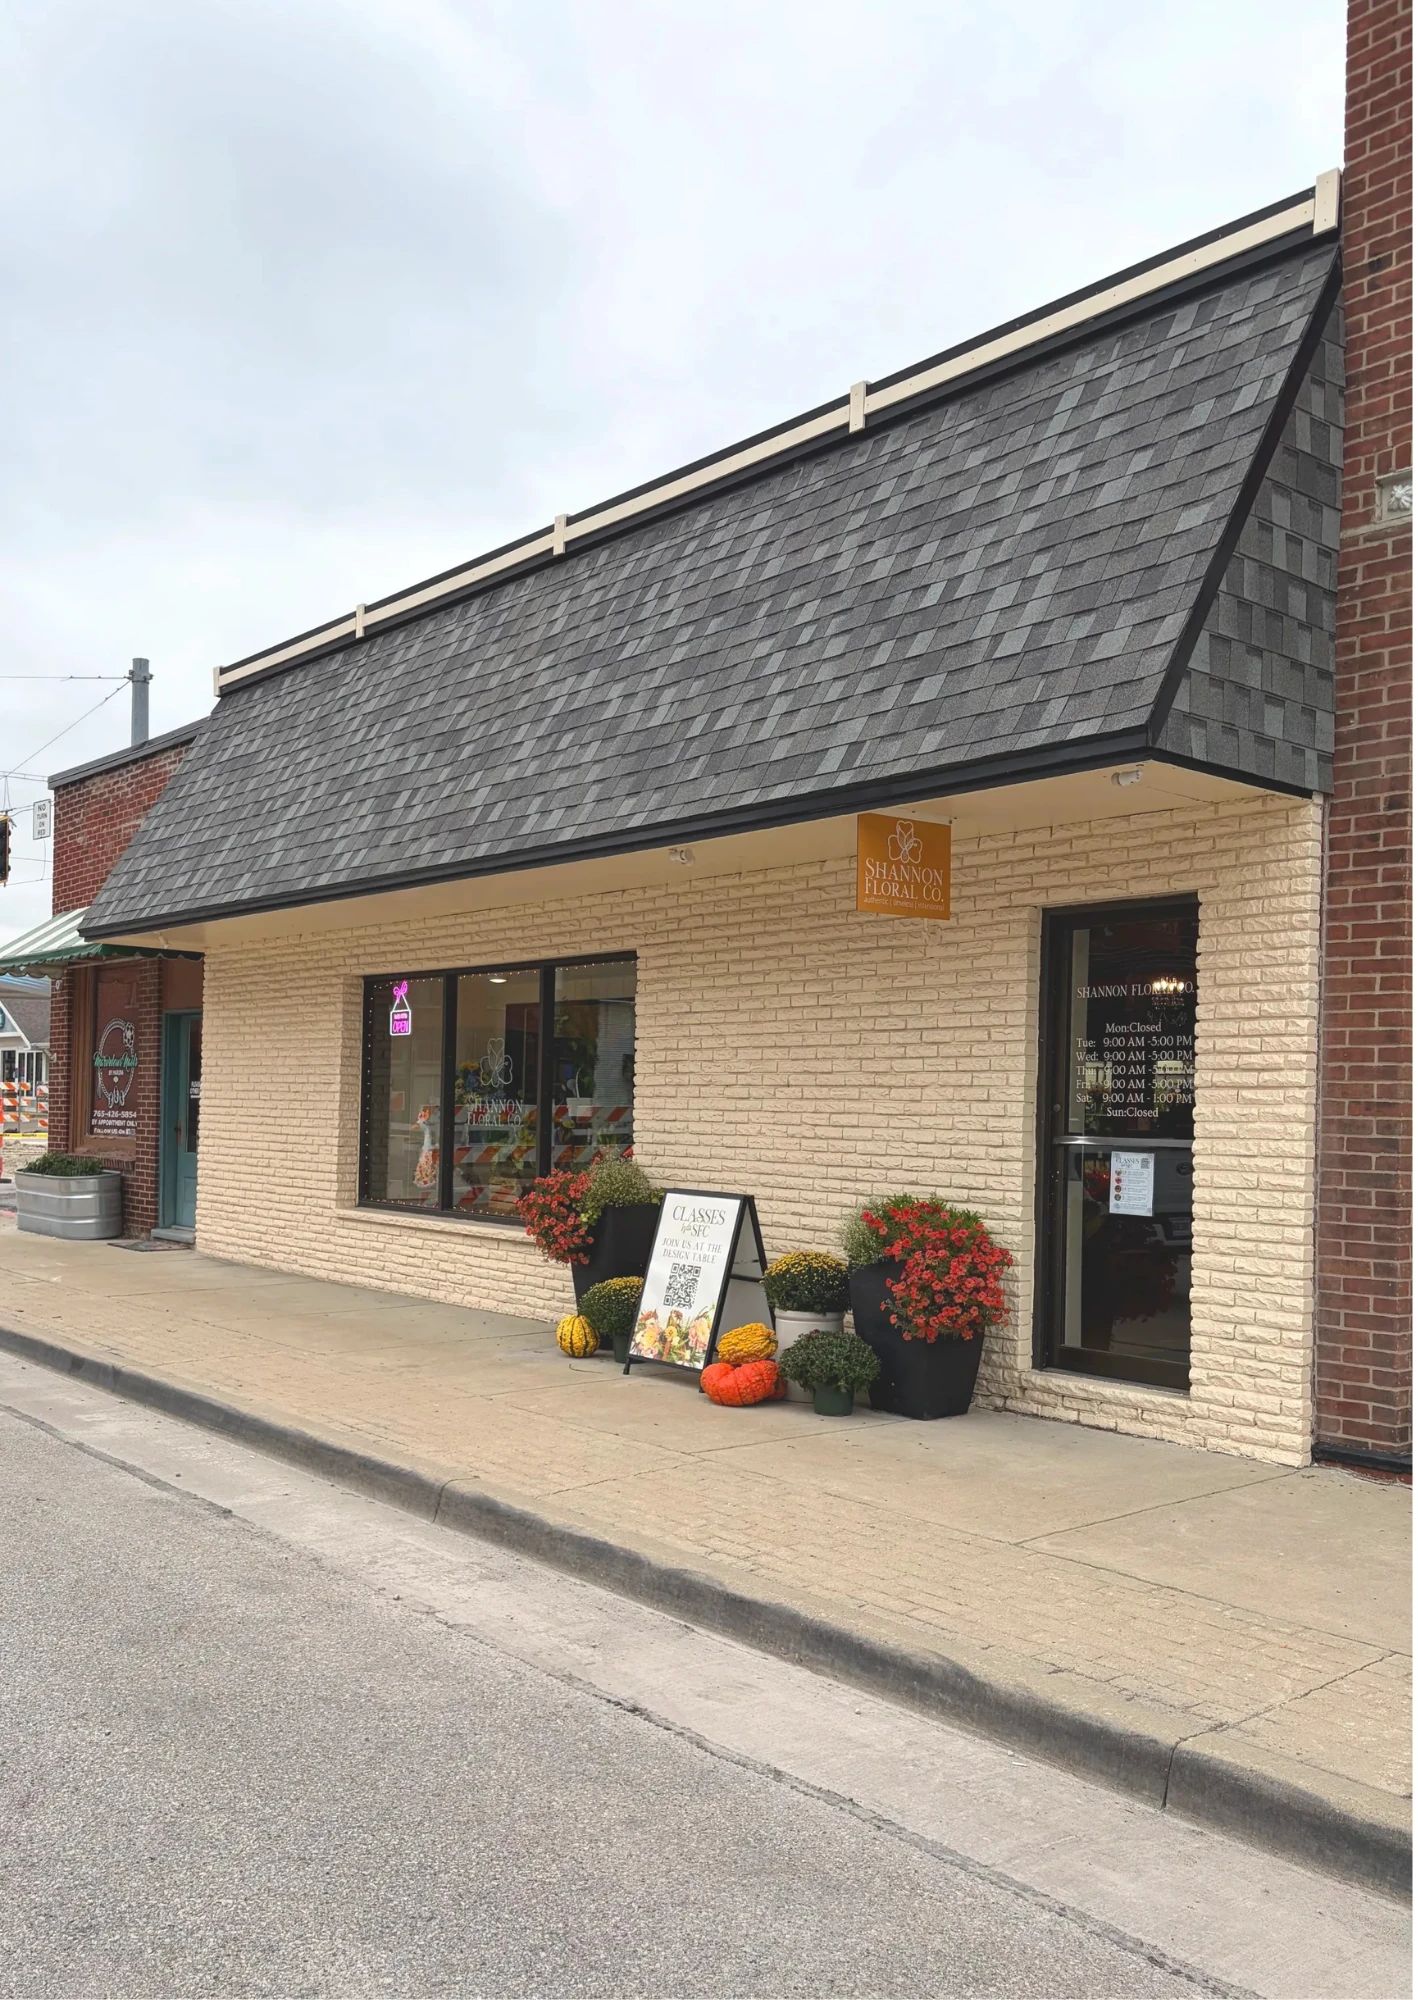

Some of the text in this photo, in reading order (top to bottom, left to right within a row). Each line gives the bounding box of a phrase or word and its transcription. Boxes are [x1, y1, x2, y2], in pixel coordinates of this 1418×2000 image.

[865, 857, 944, 887] SHANNON
[864, 876, 944, 903] FLORAL CO.
[1076, 984, 1128, 999] SHANNON
[392, 1020, 408, 1032] OPEN
[1105, 1022, 1162, 1033] Mon:Closed
[1076, 1037, 1096, 1048] Tue:
[1103, 1036, 1126, 1047] 9:00
[1128, 1036, 1145, 1046] AM
[1176, 1036, 1192, 1046] PM
[1076, 1052, 1098, 1062] Wed:
[1104, 1051, 1126, 1061] 9:00
[1128, 1051, 1146, 1060] AM
[1177, 1050, 1193, 1060] PM
[1128, 1064, 1146, 1074] AM
[1177, 1064, 1193, 1074] M
[1104, 1079, 1126, 1089] 9:00
[1128, 1079, 1145, 1089] AM
[1176, 1078, 1193, 1089] PM
[467, 1095, 524, 1113] SHANNON
[1076, 1094, 1092, 1103] Sat:
[1102, 1093, 1125, 1103] 9:00
[1127, 1093, 1144, 1103] AM
[1176, 1093, 1192, 1104] PM
[467, 1111, 505, 1127] FLORAL
[1106, 1108, 1158, 1118] Sun:Closed
[672, 1205, 726, 1226] CLASSES
[690, 1223, 711, 1238] SFC
[662, 1238, 723, 1254] JOIN US AT THE
[662, 1248, 718, 1264] DESIGN TABLE
